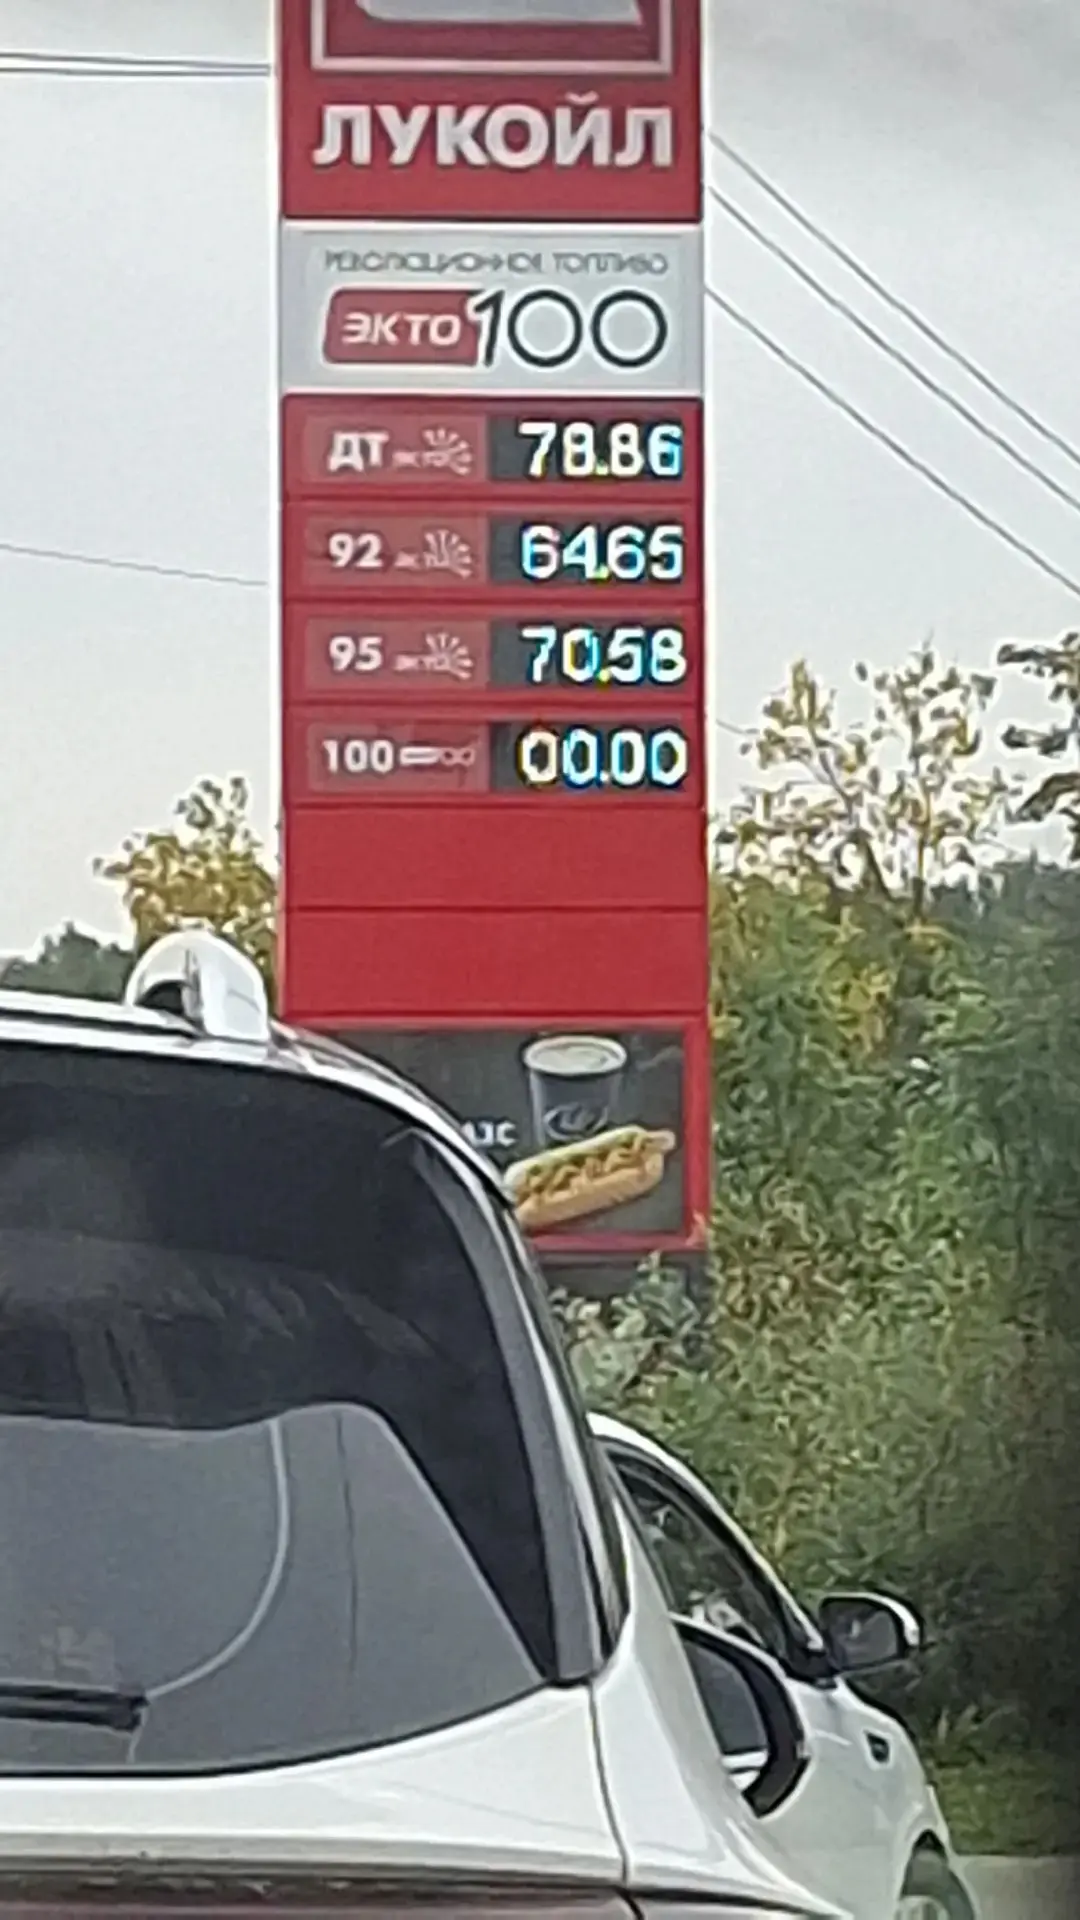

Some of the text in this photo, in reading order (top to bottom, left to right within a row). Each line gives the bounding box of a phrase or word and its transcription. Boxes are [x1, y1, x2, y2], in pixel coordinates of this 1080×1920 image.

[312, 91, 673, 168] ЛУКОЙЛ
[341, 288, 669, 369] ЭКТО 100
[327, 432, 390, 473] ДТ
[518, 421, 683, 477] 78.86
[328, 532, 384, 569] 92
[520, 524, 683, 581] 64.65
[328, 635, 384, 672] 95
[519, 625, 687, 684] 70.58
[322, 739, 394, 774] 100
[518, 729, 689, 786] 00.00
